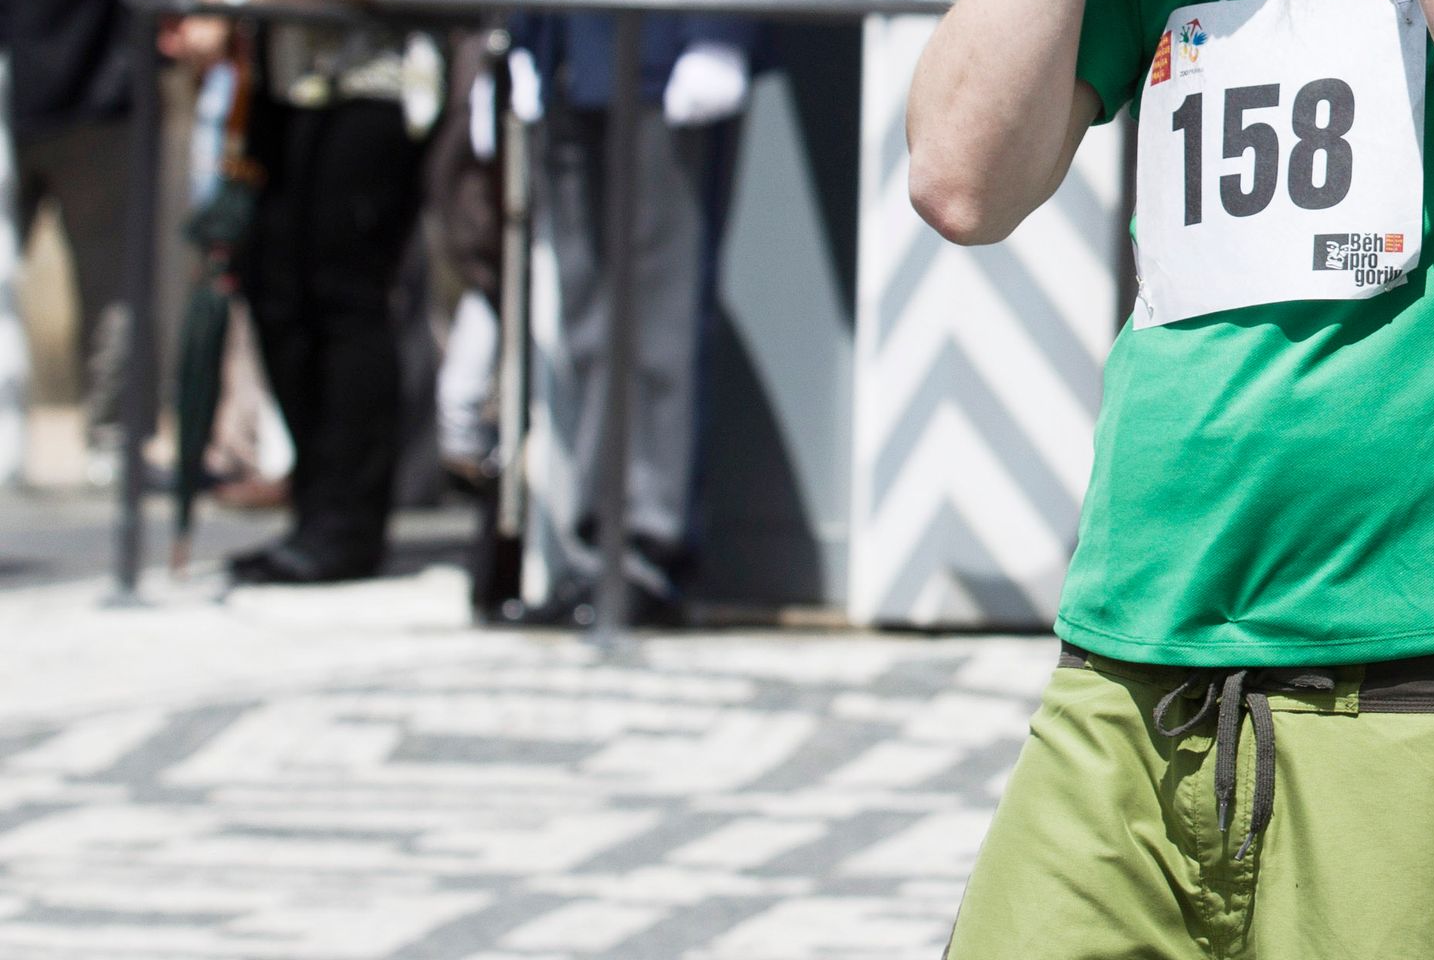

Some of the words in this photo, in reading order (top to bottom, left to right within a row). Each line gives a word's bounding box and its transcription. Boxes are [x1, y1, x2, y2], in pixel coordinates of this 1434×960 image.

[1172, 78, 1355, 227] 158
[1350, 233, 1383, 252] Běh
[1349, 252, 1378, 270] pro
